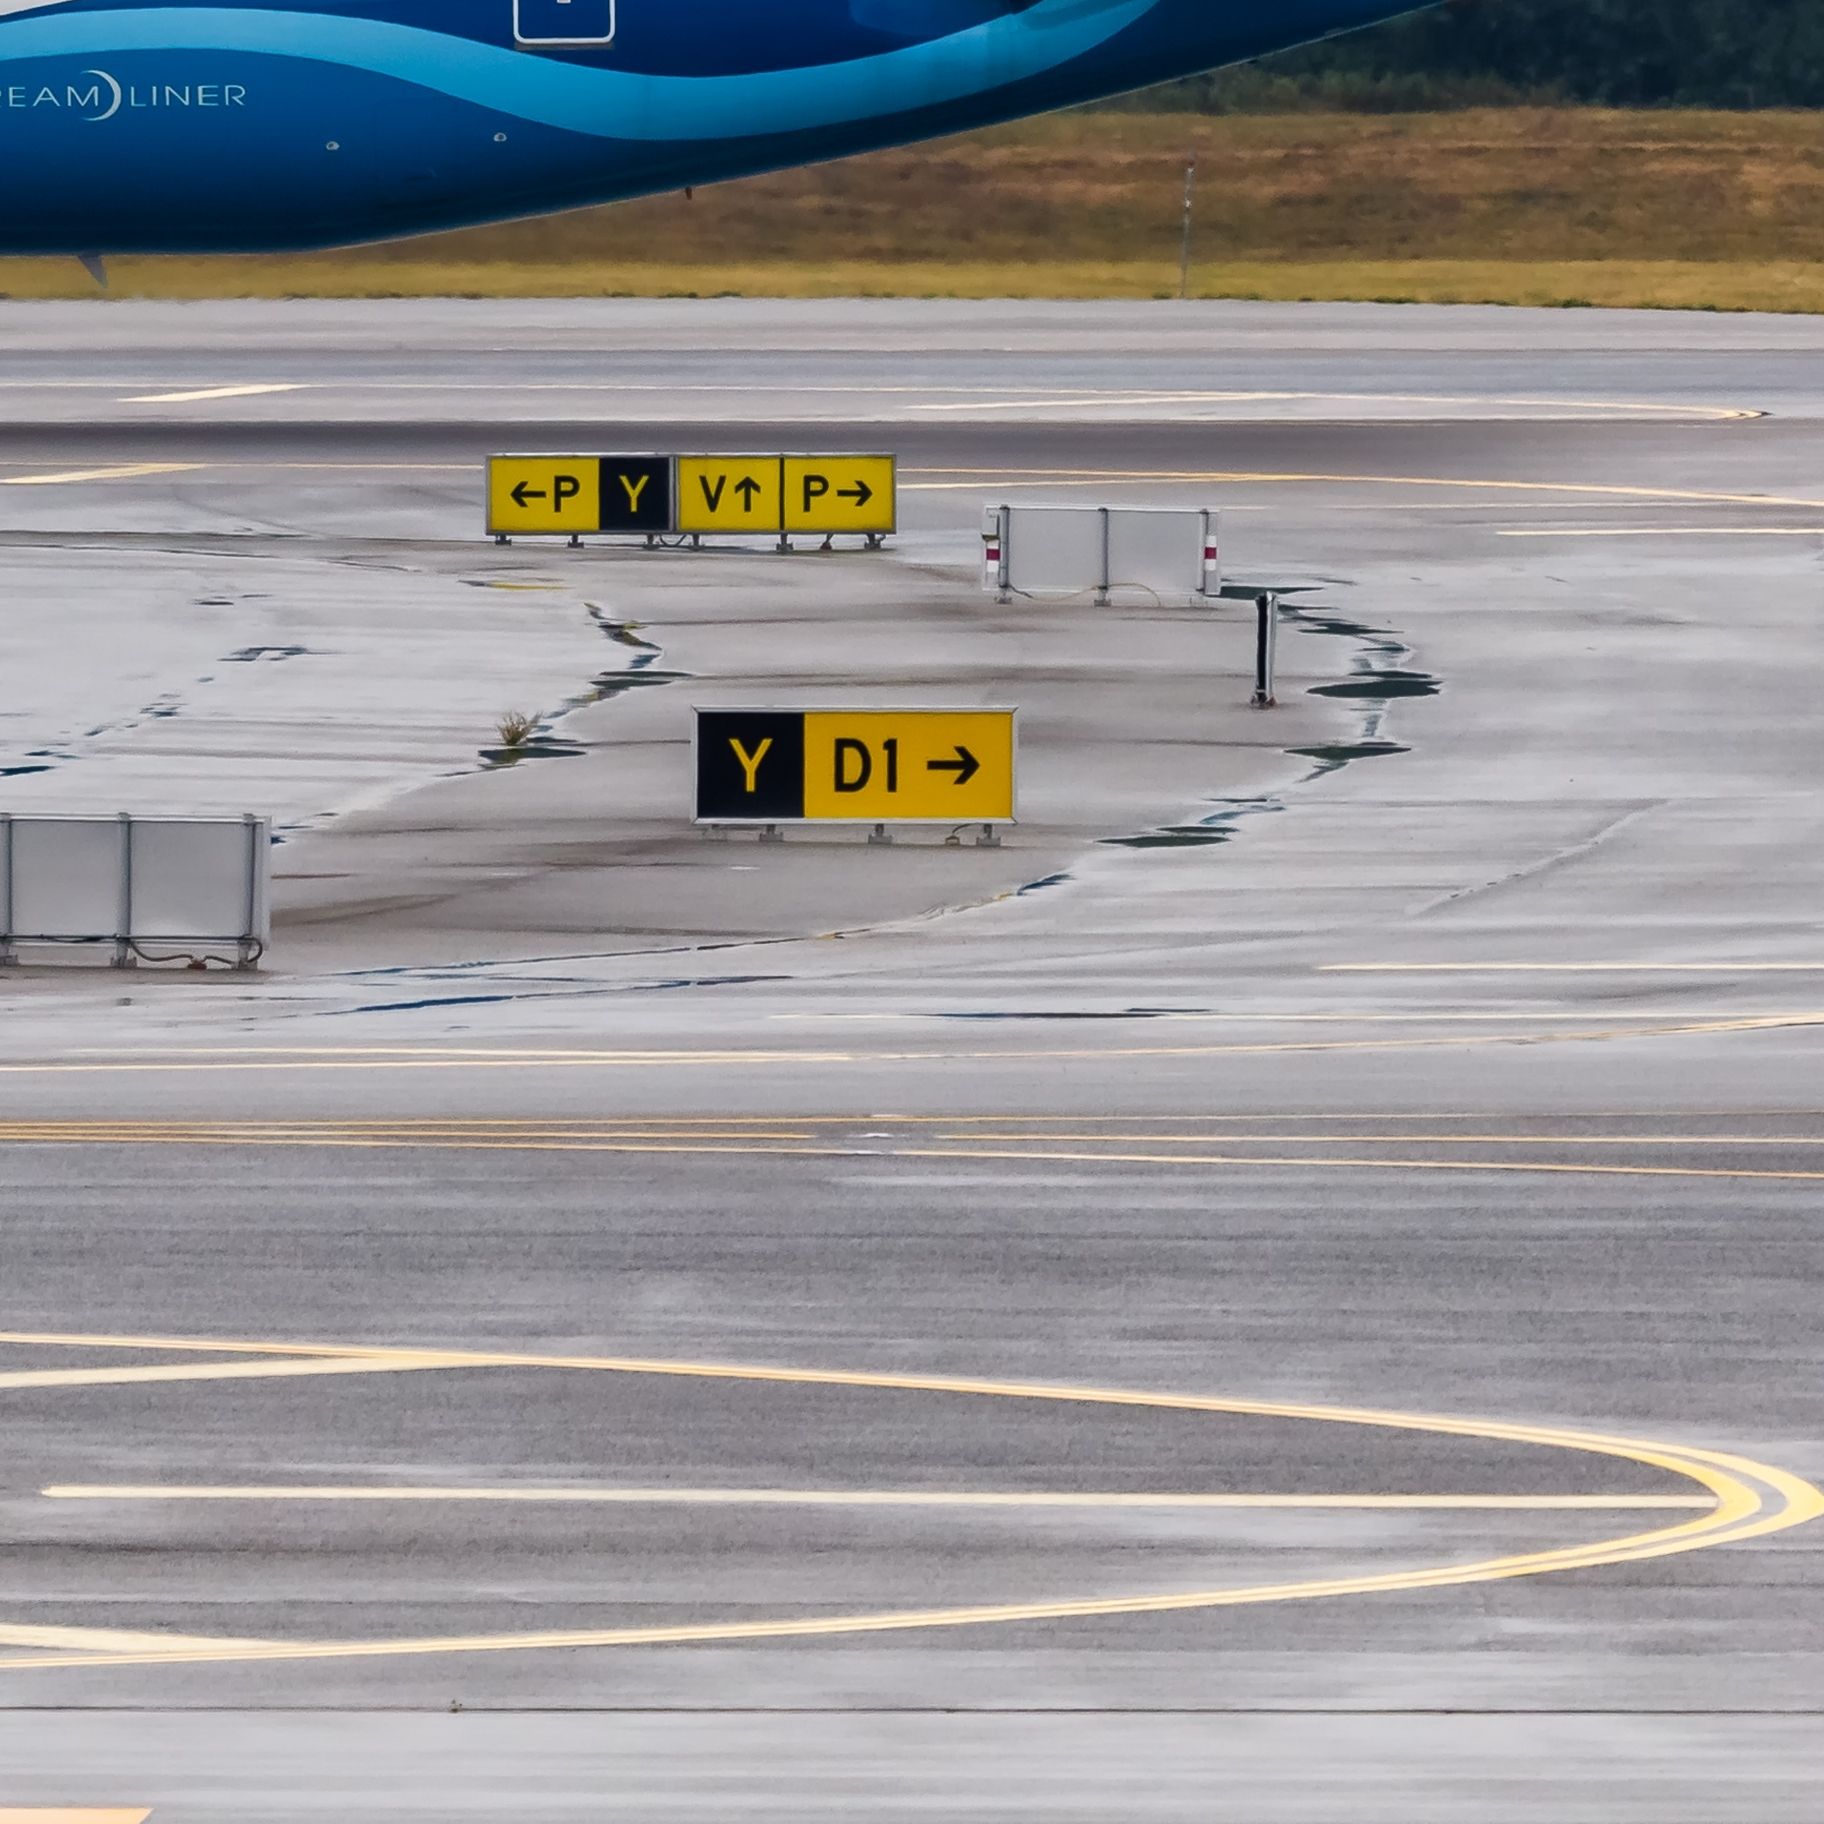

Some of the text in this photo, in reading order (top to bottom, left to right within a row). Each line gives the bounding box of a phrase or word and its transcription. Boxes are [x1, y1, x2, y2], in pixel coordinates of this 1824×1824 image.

[553, 475, 830, 513] P Y V P
[728, 737, 898, 793] Y D1
